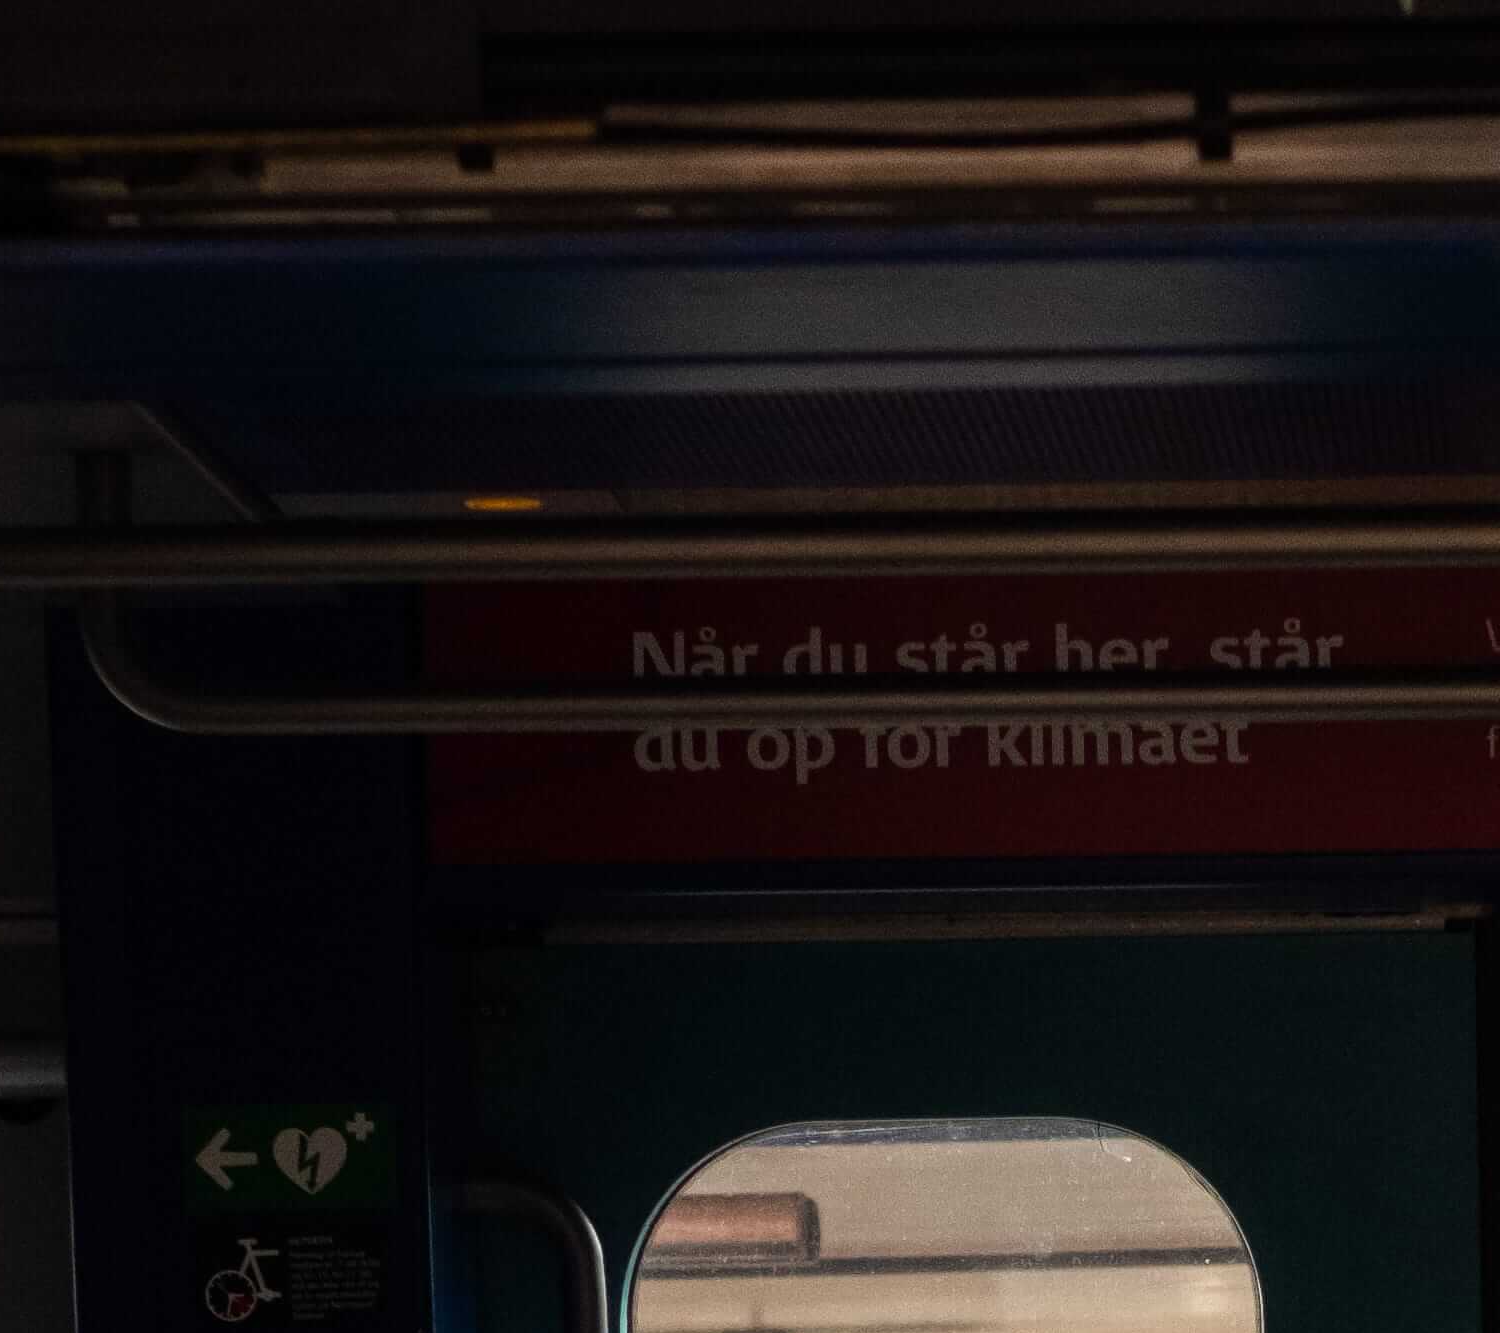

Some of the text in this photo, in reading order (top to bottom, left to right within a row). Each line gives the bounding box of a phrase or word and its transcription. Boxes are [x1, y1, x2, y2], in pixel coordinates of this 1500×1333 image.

[632, 626, 759, 676] Når
[783, 626, 867, 675] du
[895, 620, 1031, 673] står
[1210, 617, 1345, 671] står
[747, 724, 836, 784] op
